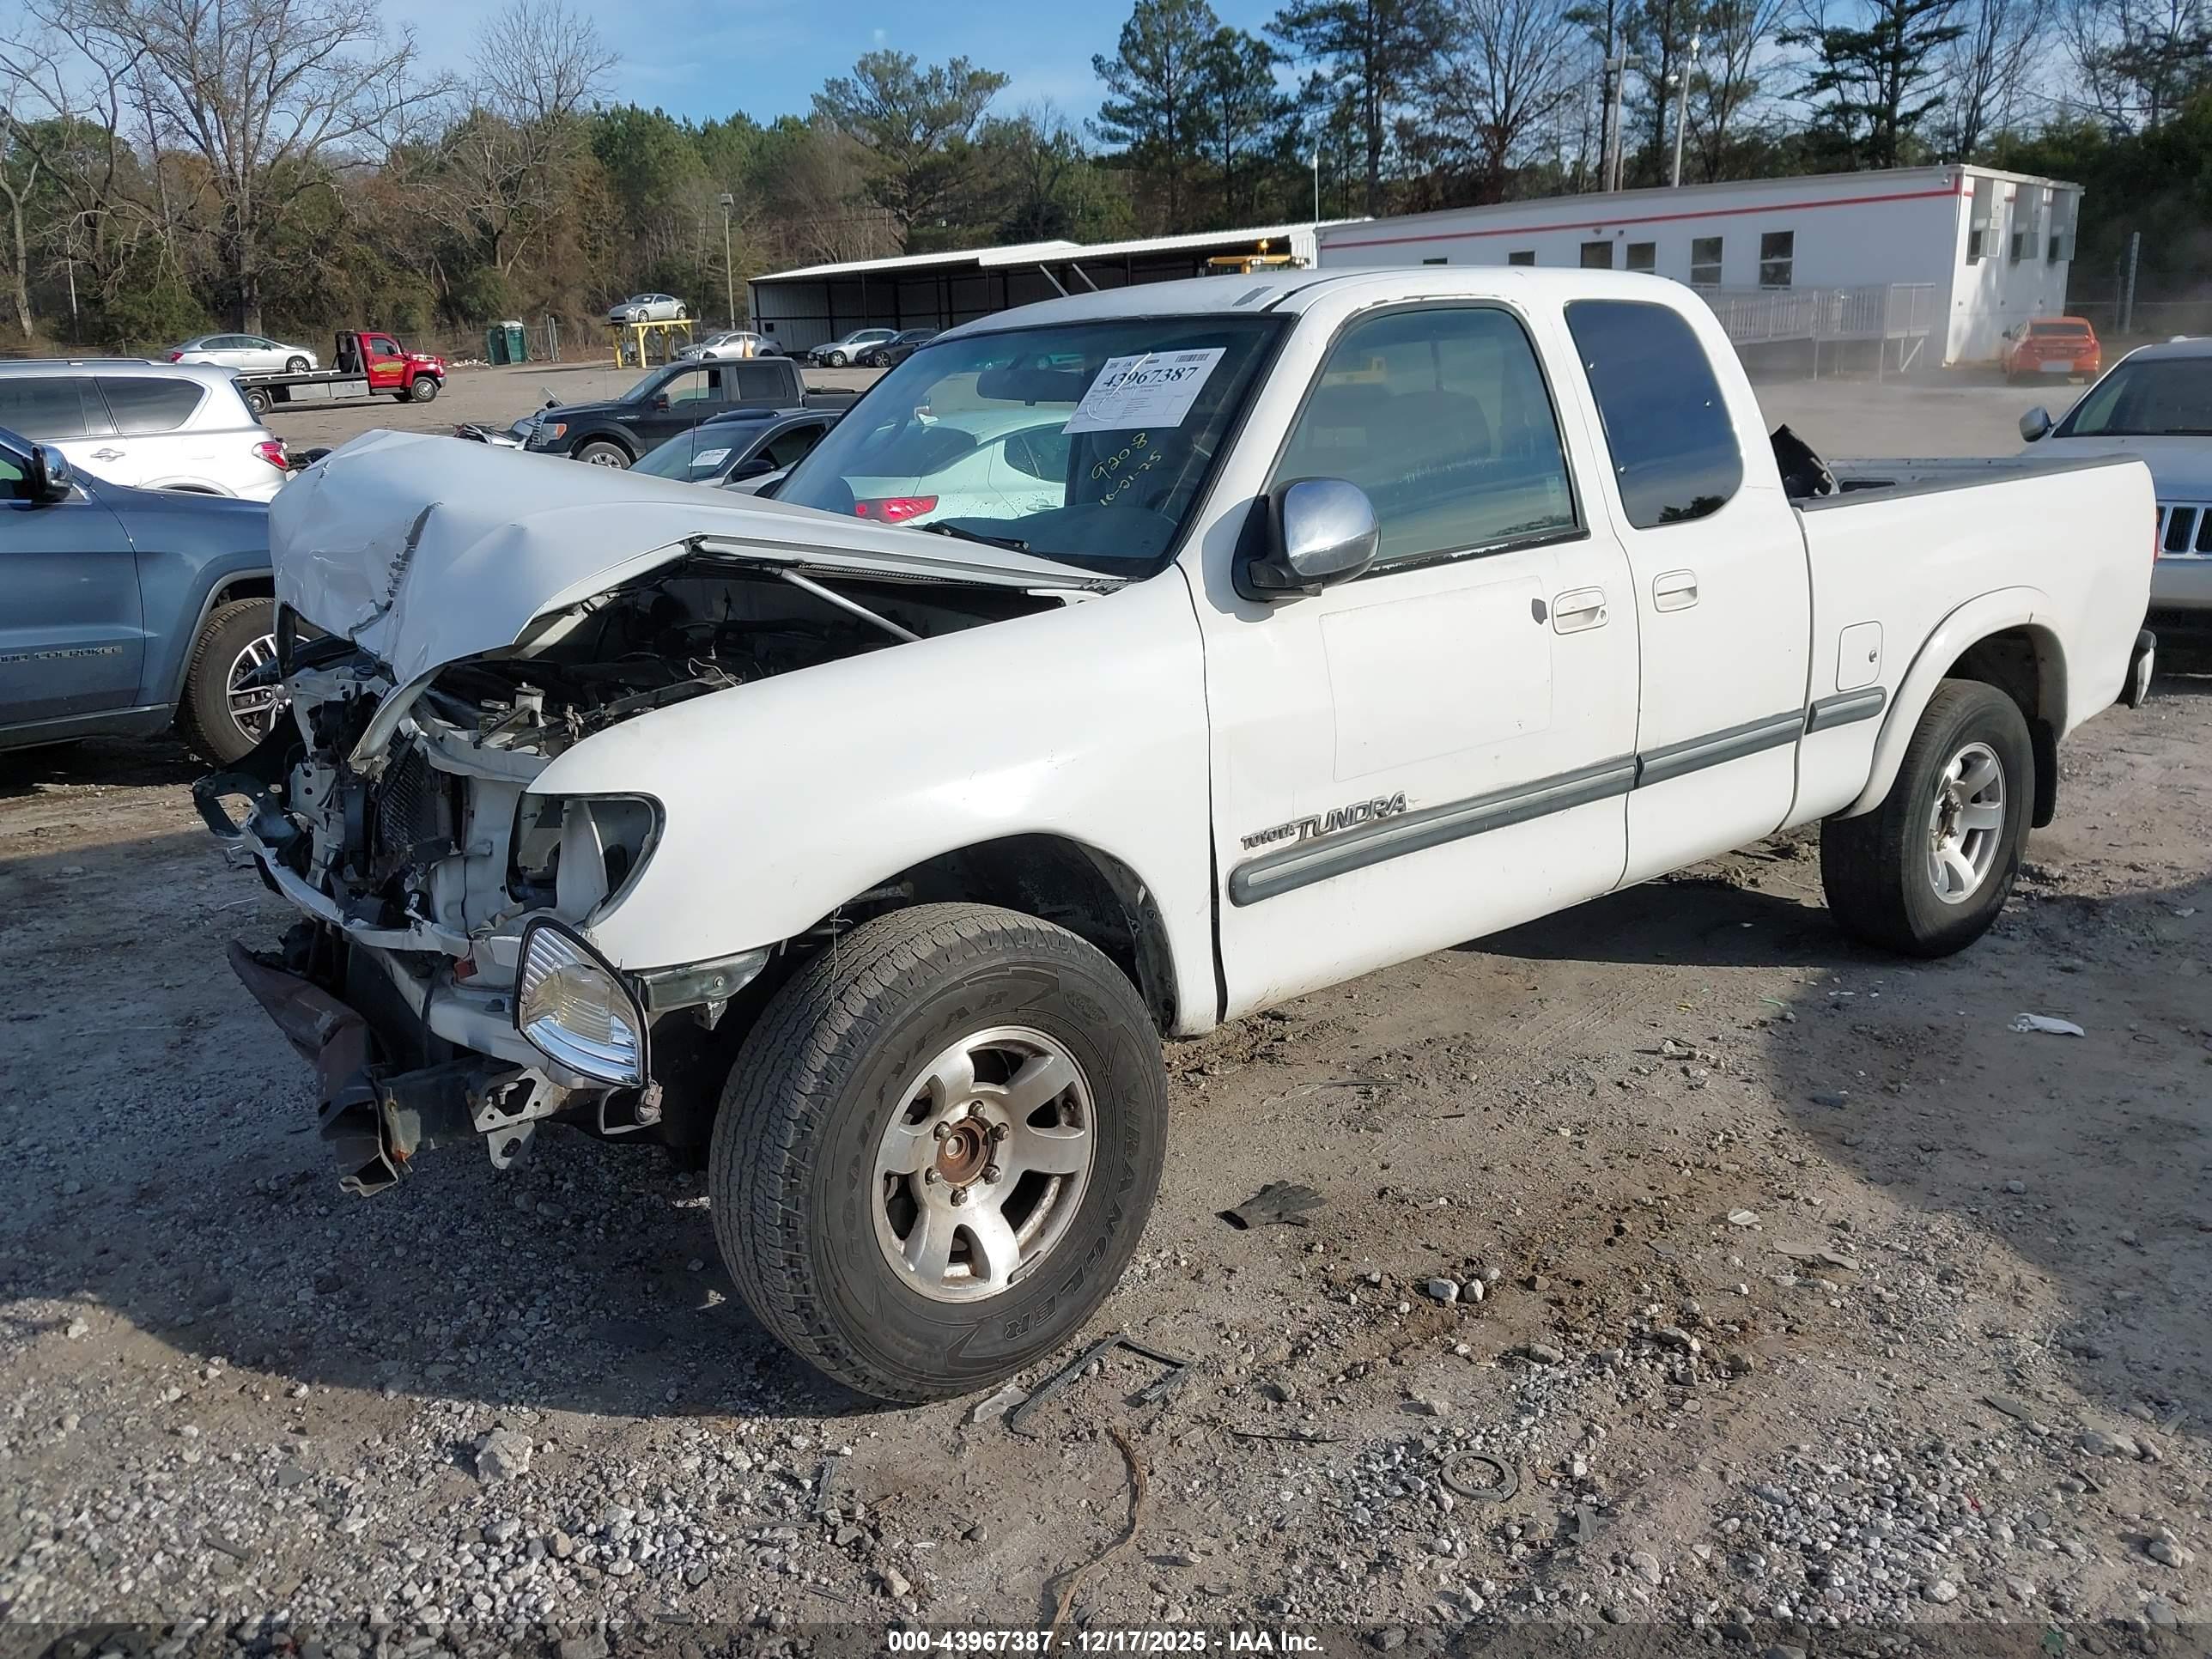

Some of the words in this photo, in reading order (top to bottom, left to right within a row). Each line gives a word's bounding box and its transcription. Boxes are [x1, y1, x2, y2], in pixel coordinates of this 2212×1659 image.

[1103, 366, 1200, 387] 43967387
[1091, 432, 1148, 479] 9208
[33, 646, 123, 660] CHEROKEE
[1240, 823, 1296, 851] TOYOTA
[1295, 790, 1407, 842] TUNDRA
[1004, 1084, 1141, 1340] WRANGLER
